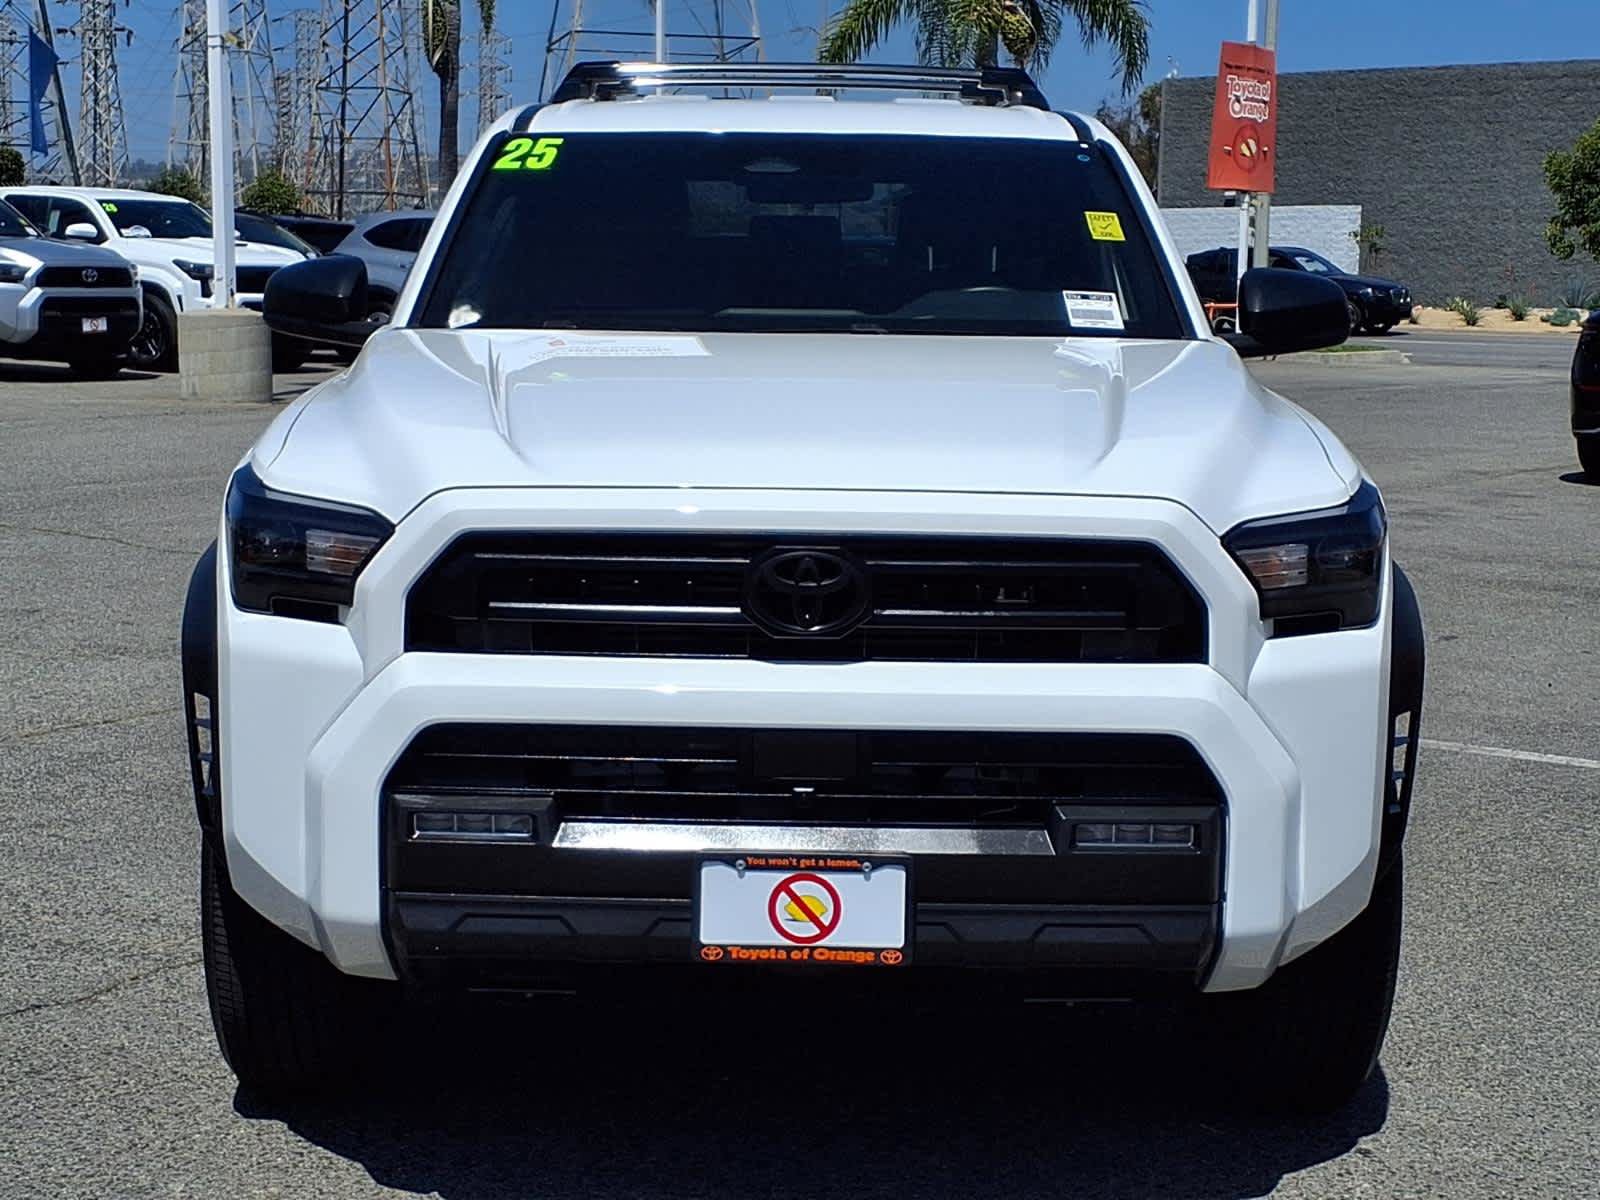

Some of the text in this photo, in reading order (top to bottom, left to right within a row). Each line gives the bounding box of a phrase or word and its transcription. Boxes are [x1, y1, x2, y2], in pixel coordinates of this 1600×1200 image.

[1226, 74, 1261, 99] Toyota
[1229, 97, 1269, 122] Orange
[493, 137, 564, 169] 25
[747, 857, 766, 866] You
[768, 857, 797, 866] won't
[800, 859, 816, 868] get
[727, 946, 876, 962] Toyota of Orange
